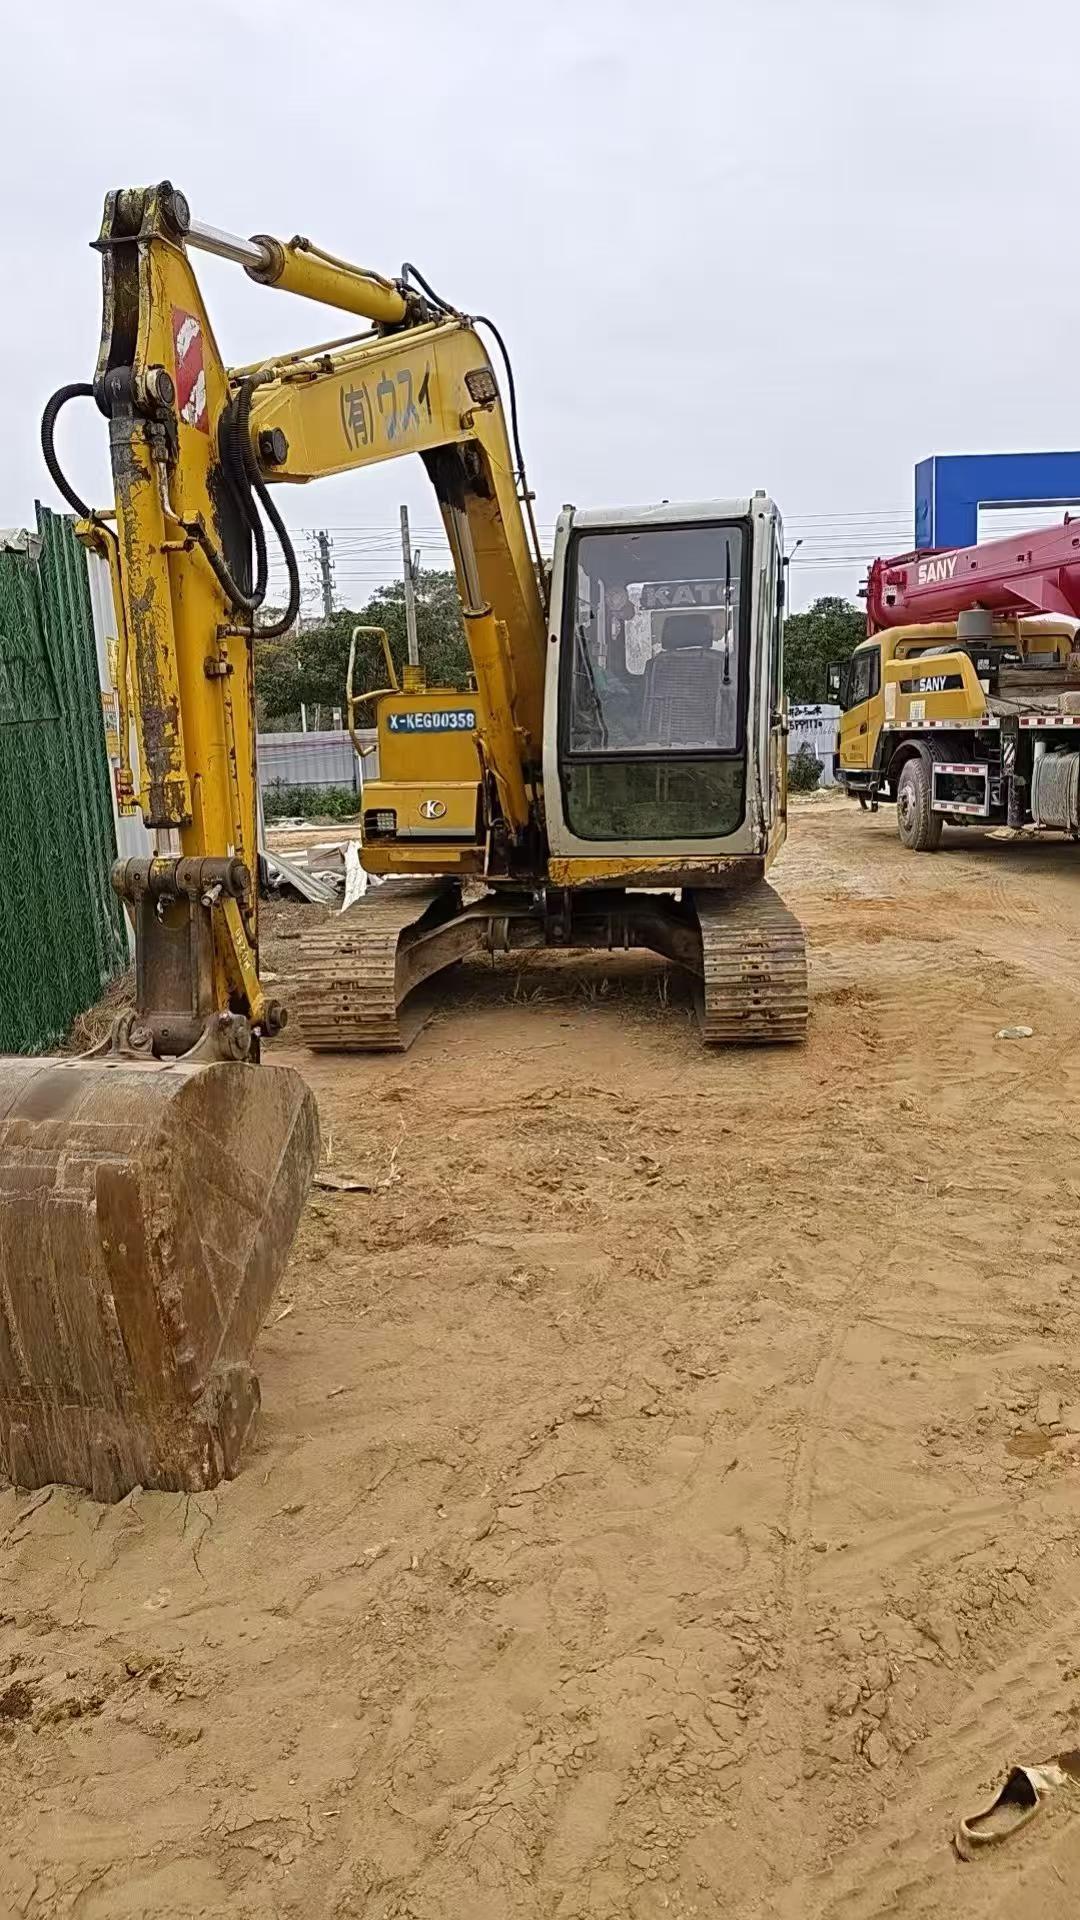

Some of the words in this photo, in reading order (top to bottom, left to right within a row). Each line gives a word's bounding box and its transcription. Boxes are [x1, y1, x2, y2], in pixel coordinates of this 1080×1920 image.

[918, 555, 958, 585] SANY
[919, 676, 947, 692] SANY
[389, 712, 475, 729] X-KEG00358
